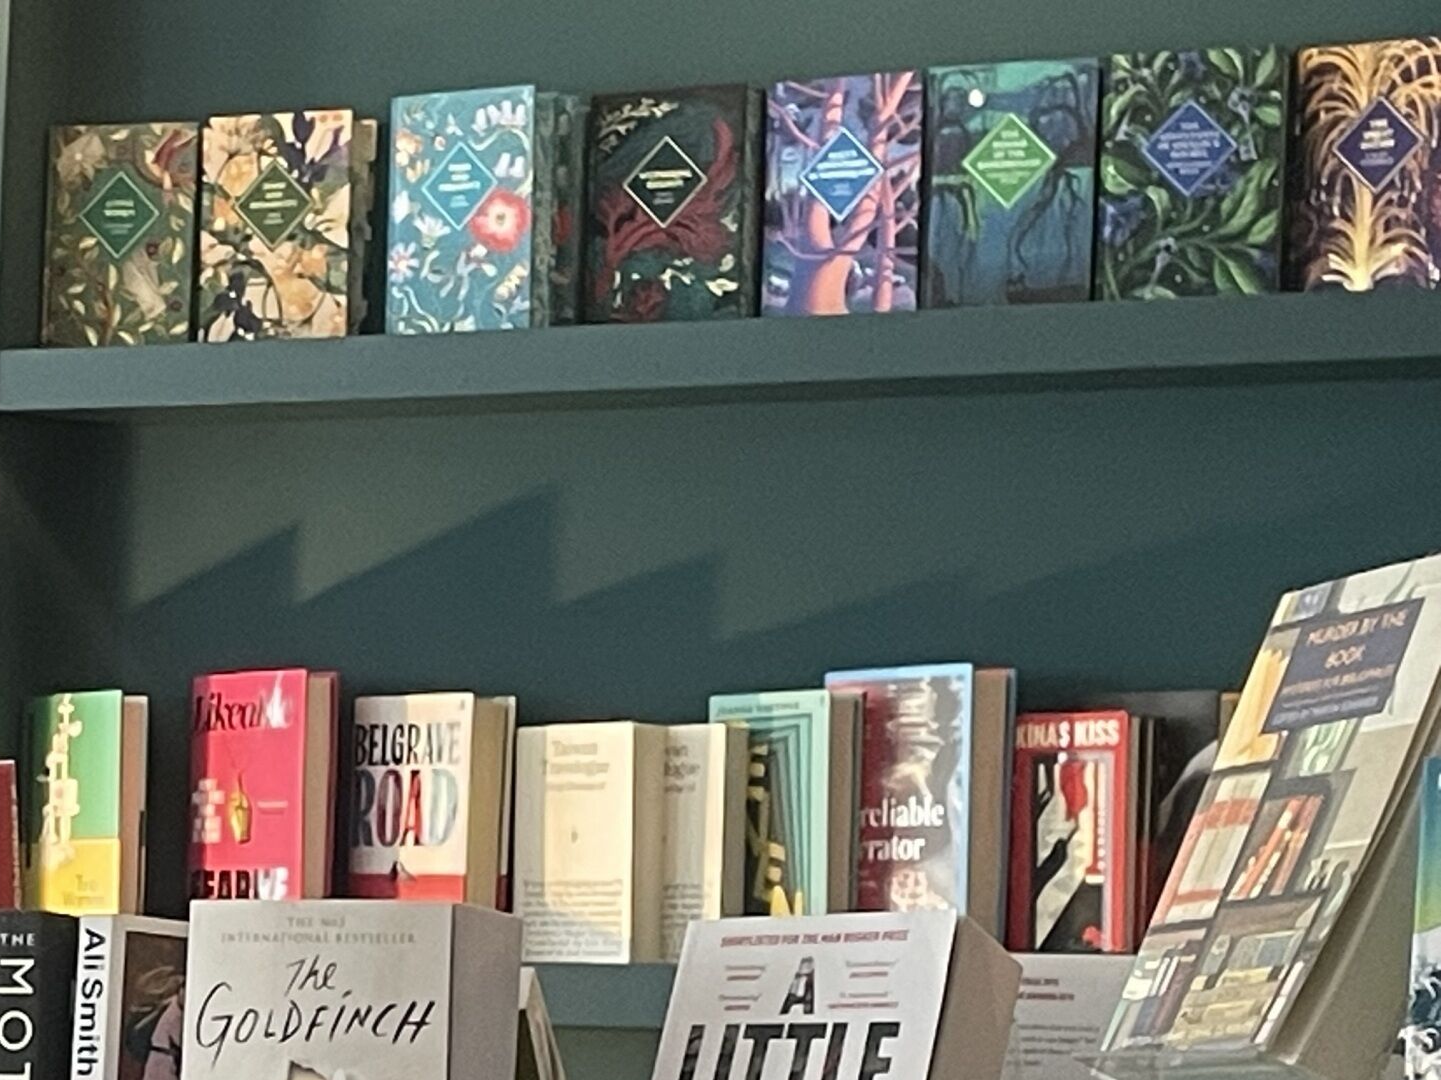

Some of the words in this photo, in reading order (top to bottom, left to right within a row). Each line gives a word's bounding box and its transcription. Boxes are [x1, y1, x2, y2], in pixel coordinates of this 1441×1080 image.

[355, 723, 461, 767] BELGRAVE
[1073, 718, 1120, 746] KISS
[353, 769, 458, 849] ROAD
[0, 933, 35, 946] THE
[84, 928, 106, 970] Ali
[284, 954, 338, 996] The
[778, 955, 815, 1015] A
[77, 976, 103, 1077] Smith
[195, 981, 436, 1070] GOLDFINCH
